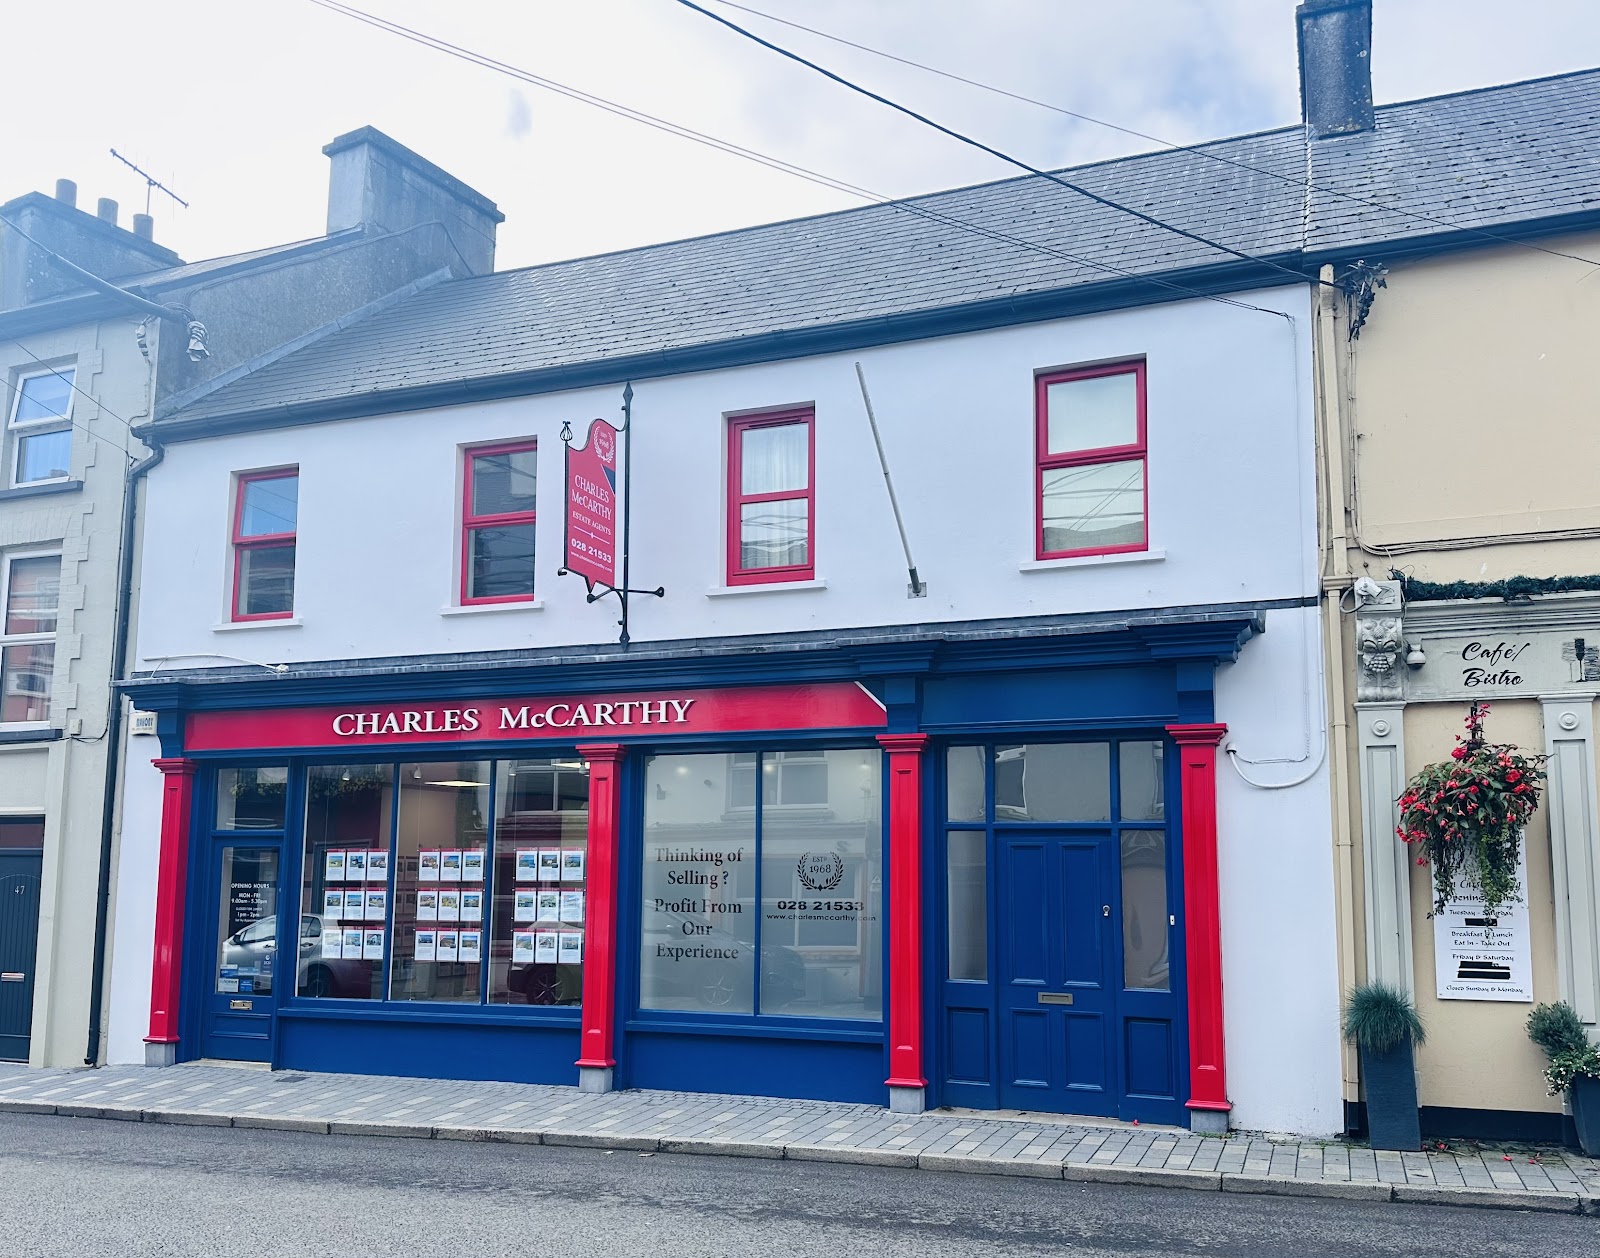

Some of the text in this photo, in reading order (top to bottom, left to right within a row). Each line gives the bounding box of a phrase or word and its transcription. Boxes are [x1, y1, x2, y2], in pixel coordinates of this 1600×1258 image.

[574, 475, 609, 503] CHARLES
[571, 489, 612, 520] McCARTHY
[572, 511, 611, 536] ESTATE AGENTS
[571, 538, 611, 563] 028 21533
[1463, 668, 1523, 687] Bistro
[332, 699, 694, 736] CHARLES McCARTHY
[655, 847, 744, 866] Thinking of
[810, 864, 831, 874] 1968
[667, 870, 718, 889] Selling
[14, 886, 25, 894] 47
[654, 898, 742, 913] Profit From
[777, 901, 864, 911] 028 21533
[766, 914, 876, 922] www.charlesmccarthy.com
[682, 921, 713, 935] Our
[656, 943, 739, 962] Experience
